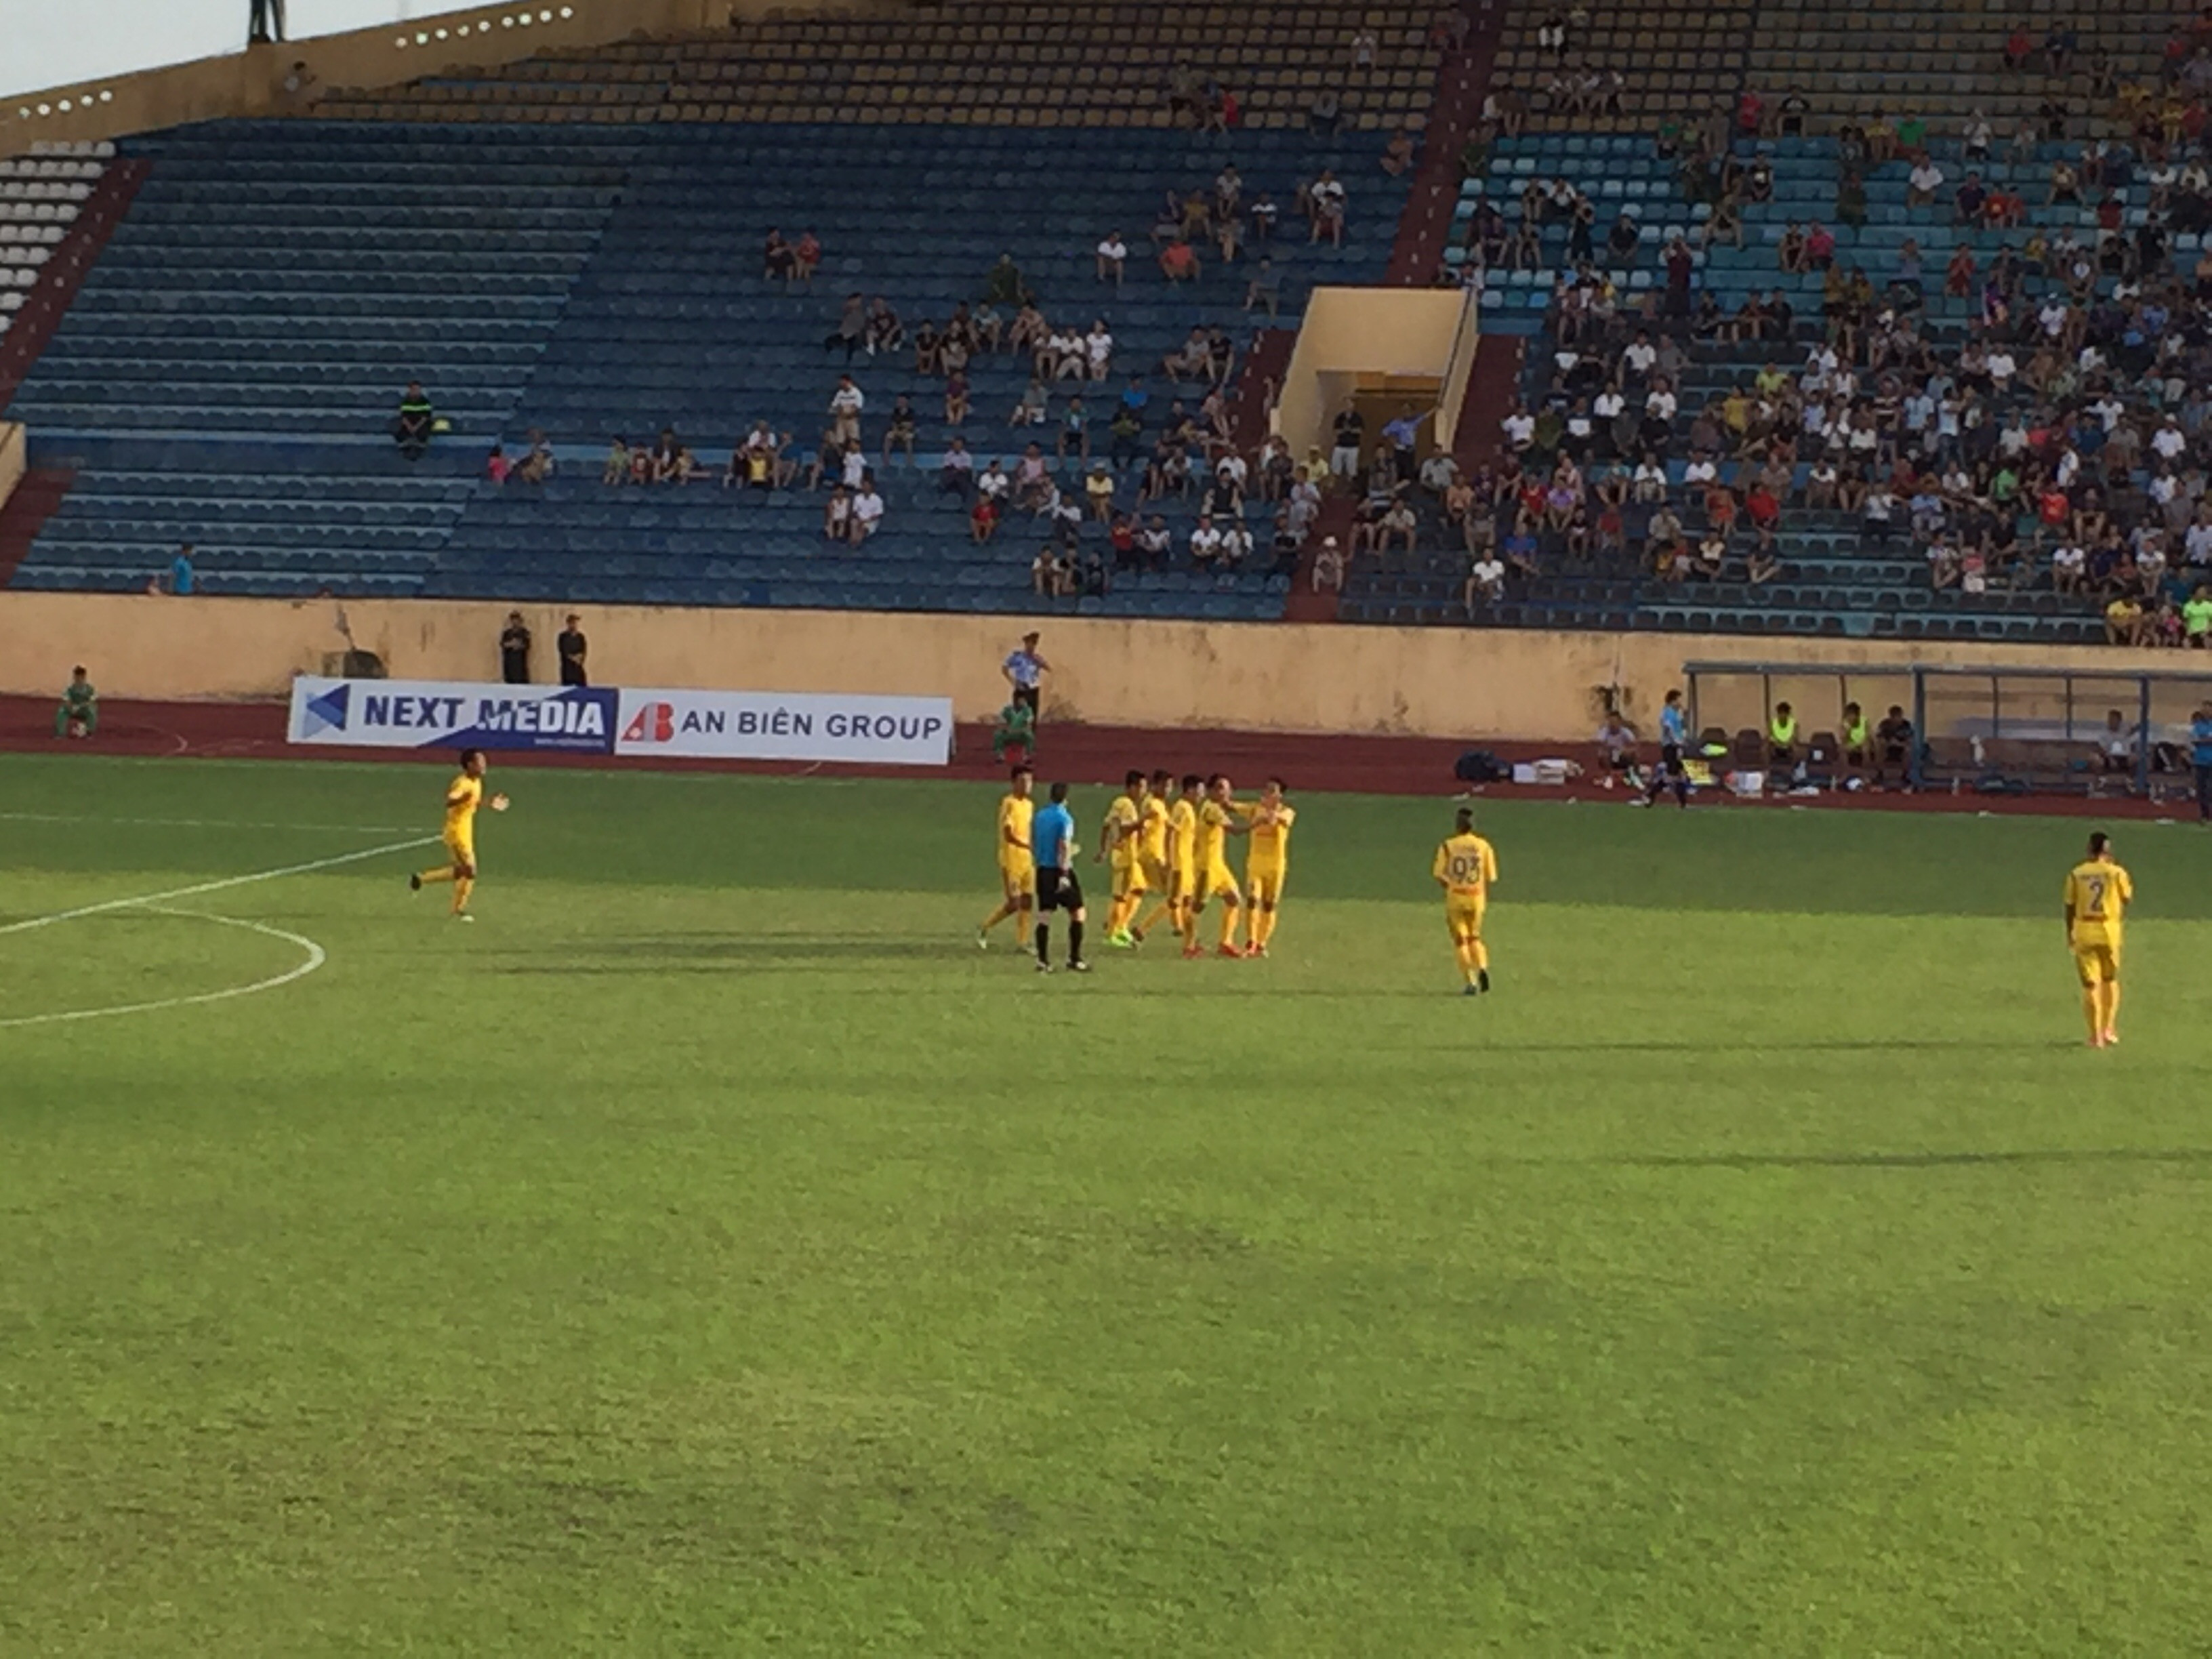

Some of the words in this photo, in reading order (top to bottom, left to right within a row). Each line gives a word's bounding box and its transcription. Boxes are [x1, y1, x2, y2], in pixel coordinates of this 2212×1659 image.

[365, 696, 464, 728] NEXT
[476, 699, 605, 734] MEDIA
[680, 711, 725, 734] AN
[738, 707, 813, 736] BIÊN
[825, 714, 942, 740] GROUP
[2089, 880, 2104, 912] 2
